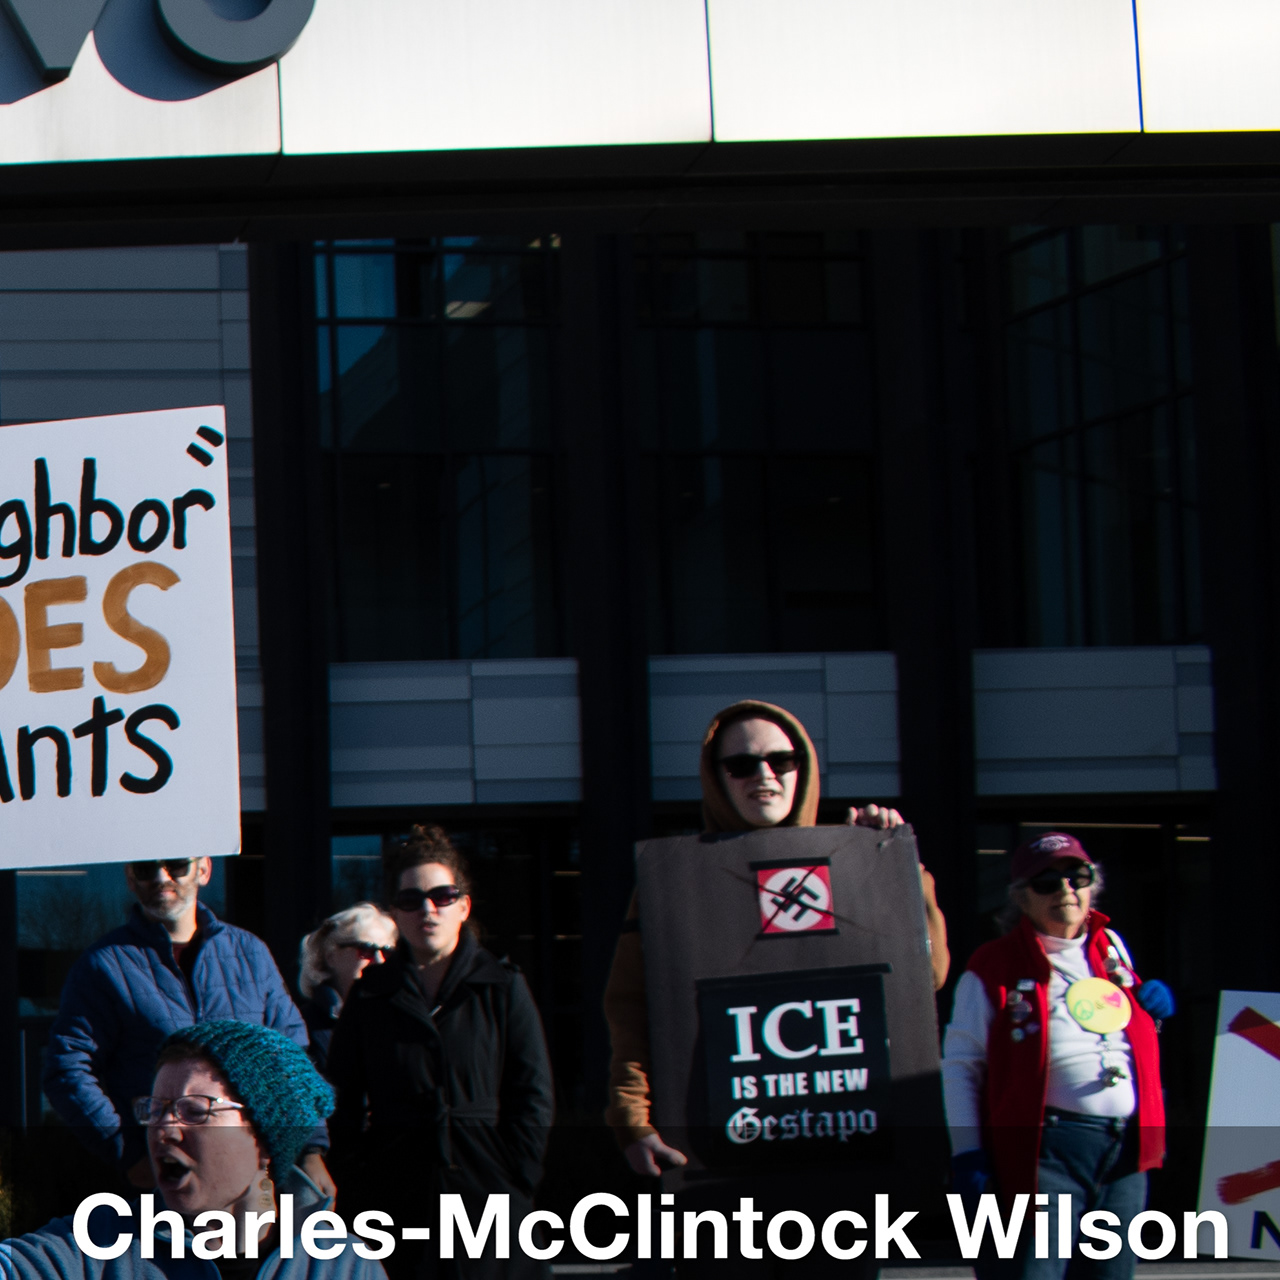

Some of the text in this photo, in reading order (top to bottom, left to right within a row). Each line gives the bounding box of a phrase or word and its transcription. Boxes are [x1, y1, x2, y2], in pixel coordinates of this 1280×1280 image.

[726, 998, 865, 1063] ICE
[731, 1067, 869, 1100] IS THE NEW
[725, 1106, 878, 1144] Gestapo
